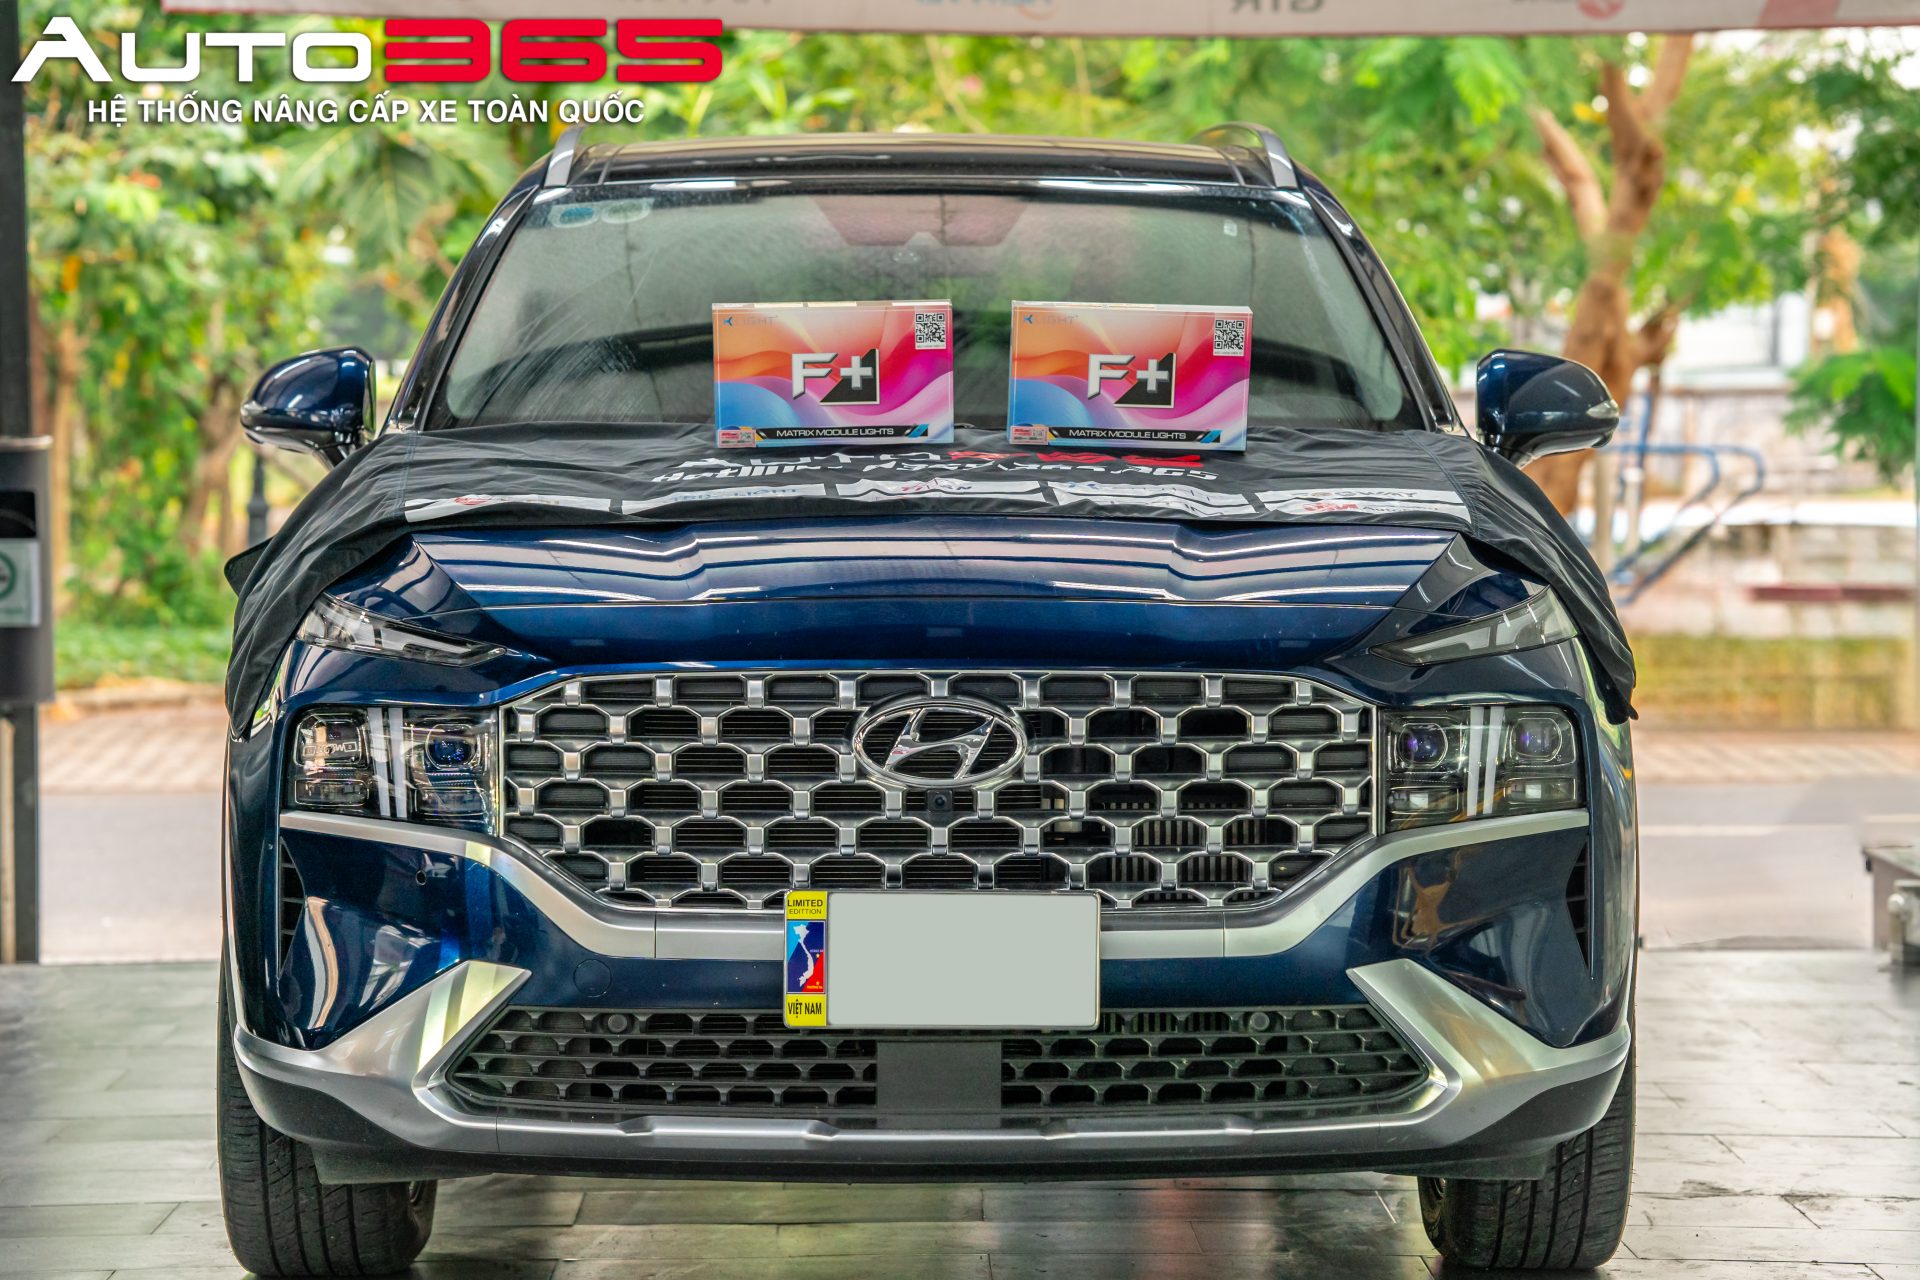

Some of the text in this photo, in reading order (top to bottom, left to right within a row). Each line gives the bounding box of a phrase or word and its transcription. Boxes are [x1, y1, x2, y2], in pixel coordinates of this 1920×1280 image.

[776, 427, 894, 438] MATRIX MODULE LIGHTS
[1069, 429, 1187, 440] MATRIX MODULE LIGHTS
[787, 899, 824, 908] LIMITED
[787, 998, 822, 1018] VIỆT NAM
